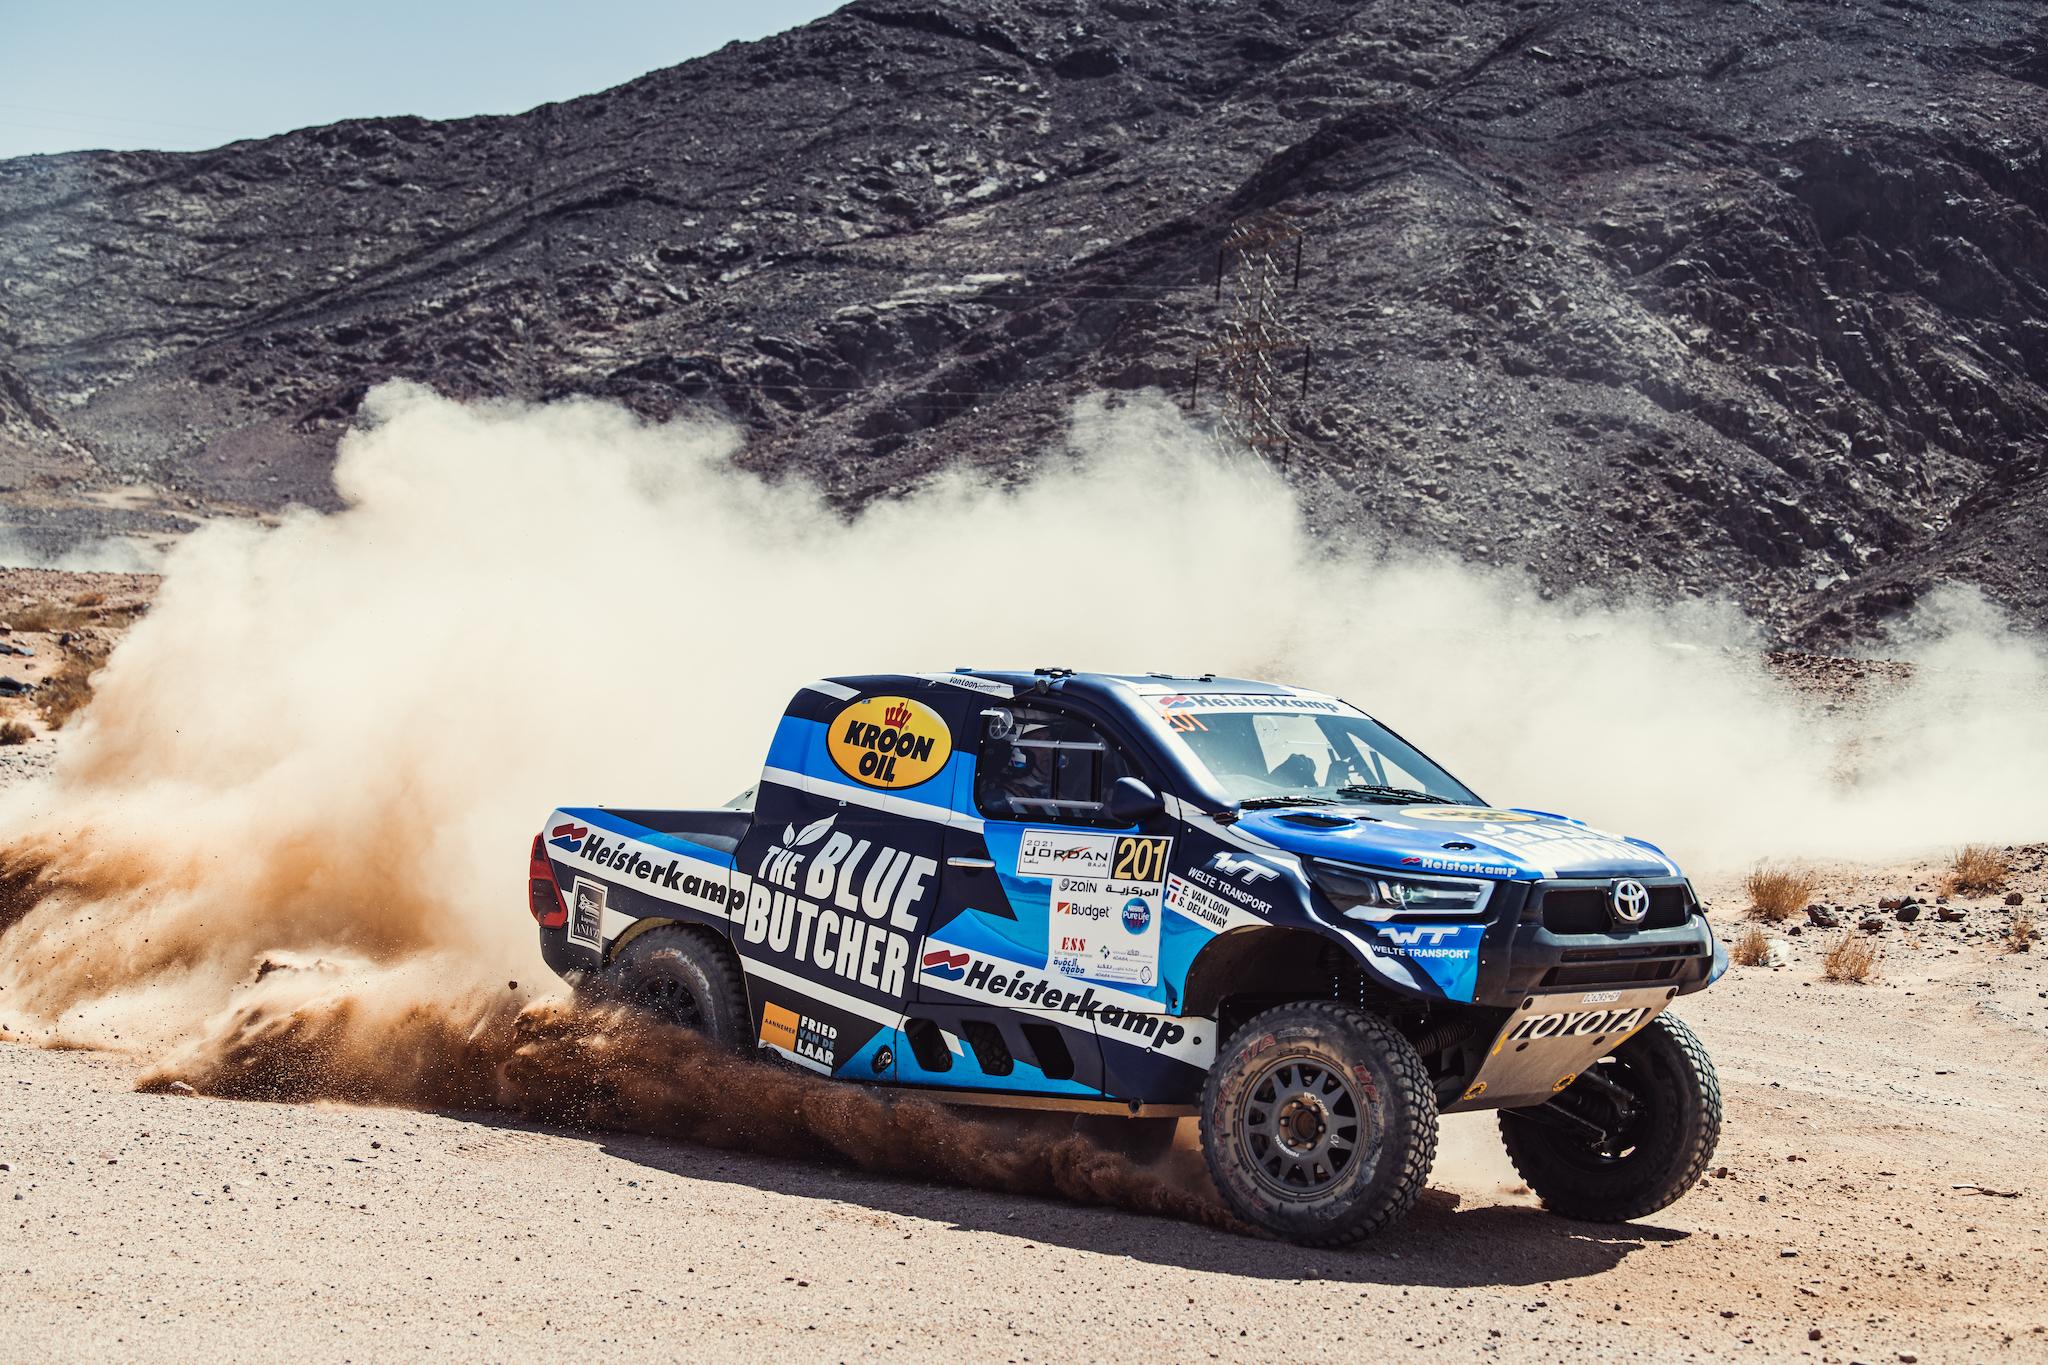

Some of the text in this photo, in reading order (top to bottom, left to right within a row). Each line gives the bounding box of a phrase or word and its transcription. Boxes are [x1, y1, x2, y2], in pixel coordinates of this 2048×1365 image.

[1190, 695, 1340, 713] Heisterkamp
[843, 719, 936, 763] KROON
[858, 751, 897, 783] OIL
[1024, 846, 1109, 862] JORDAN
[1113, 837, 1167, 882] 201
[1420, 857, 1518, 877] Heisterkamp
[580, 833, 746, 913] Heisterkamp
[757, 831, 938, 933] THE BLUE
[1105, 884, 1160, 898] المركزية
[1182, 885, 1231, 917] E. VAN LOON
[1187, 866, 1273, 915] WELTE TRANSPORT
[1071, 903, 1110, 921] Budget
[1177, 896, 1228, 929] S. DELAUNAY
[743, 882, 910, 998] BUTCHER
[1061, 936, 1087, 952] ESS
[1371, 945, 1470, 960] WELTE TRANSPORT
[1060, 964, 1086, 975] aqaba
[963, 959, 1185, 1049] Heisterkamp
[764, 1018, 796, 1034] AANNEMER
[800, 1015, 838, 1040] FRIED
[1508, 1007, 1649, 1041] TOYOTA
[796, 1038, 835, 1066] LAAR
[799, 1028, 835, 1051] VAN DE
